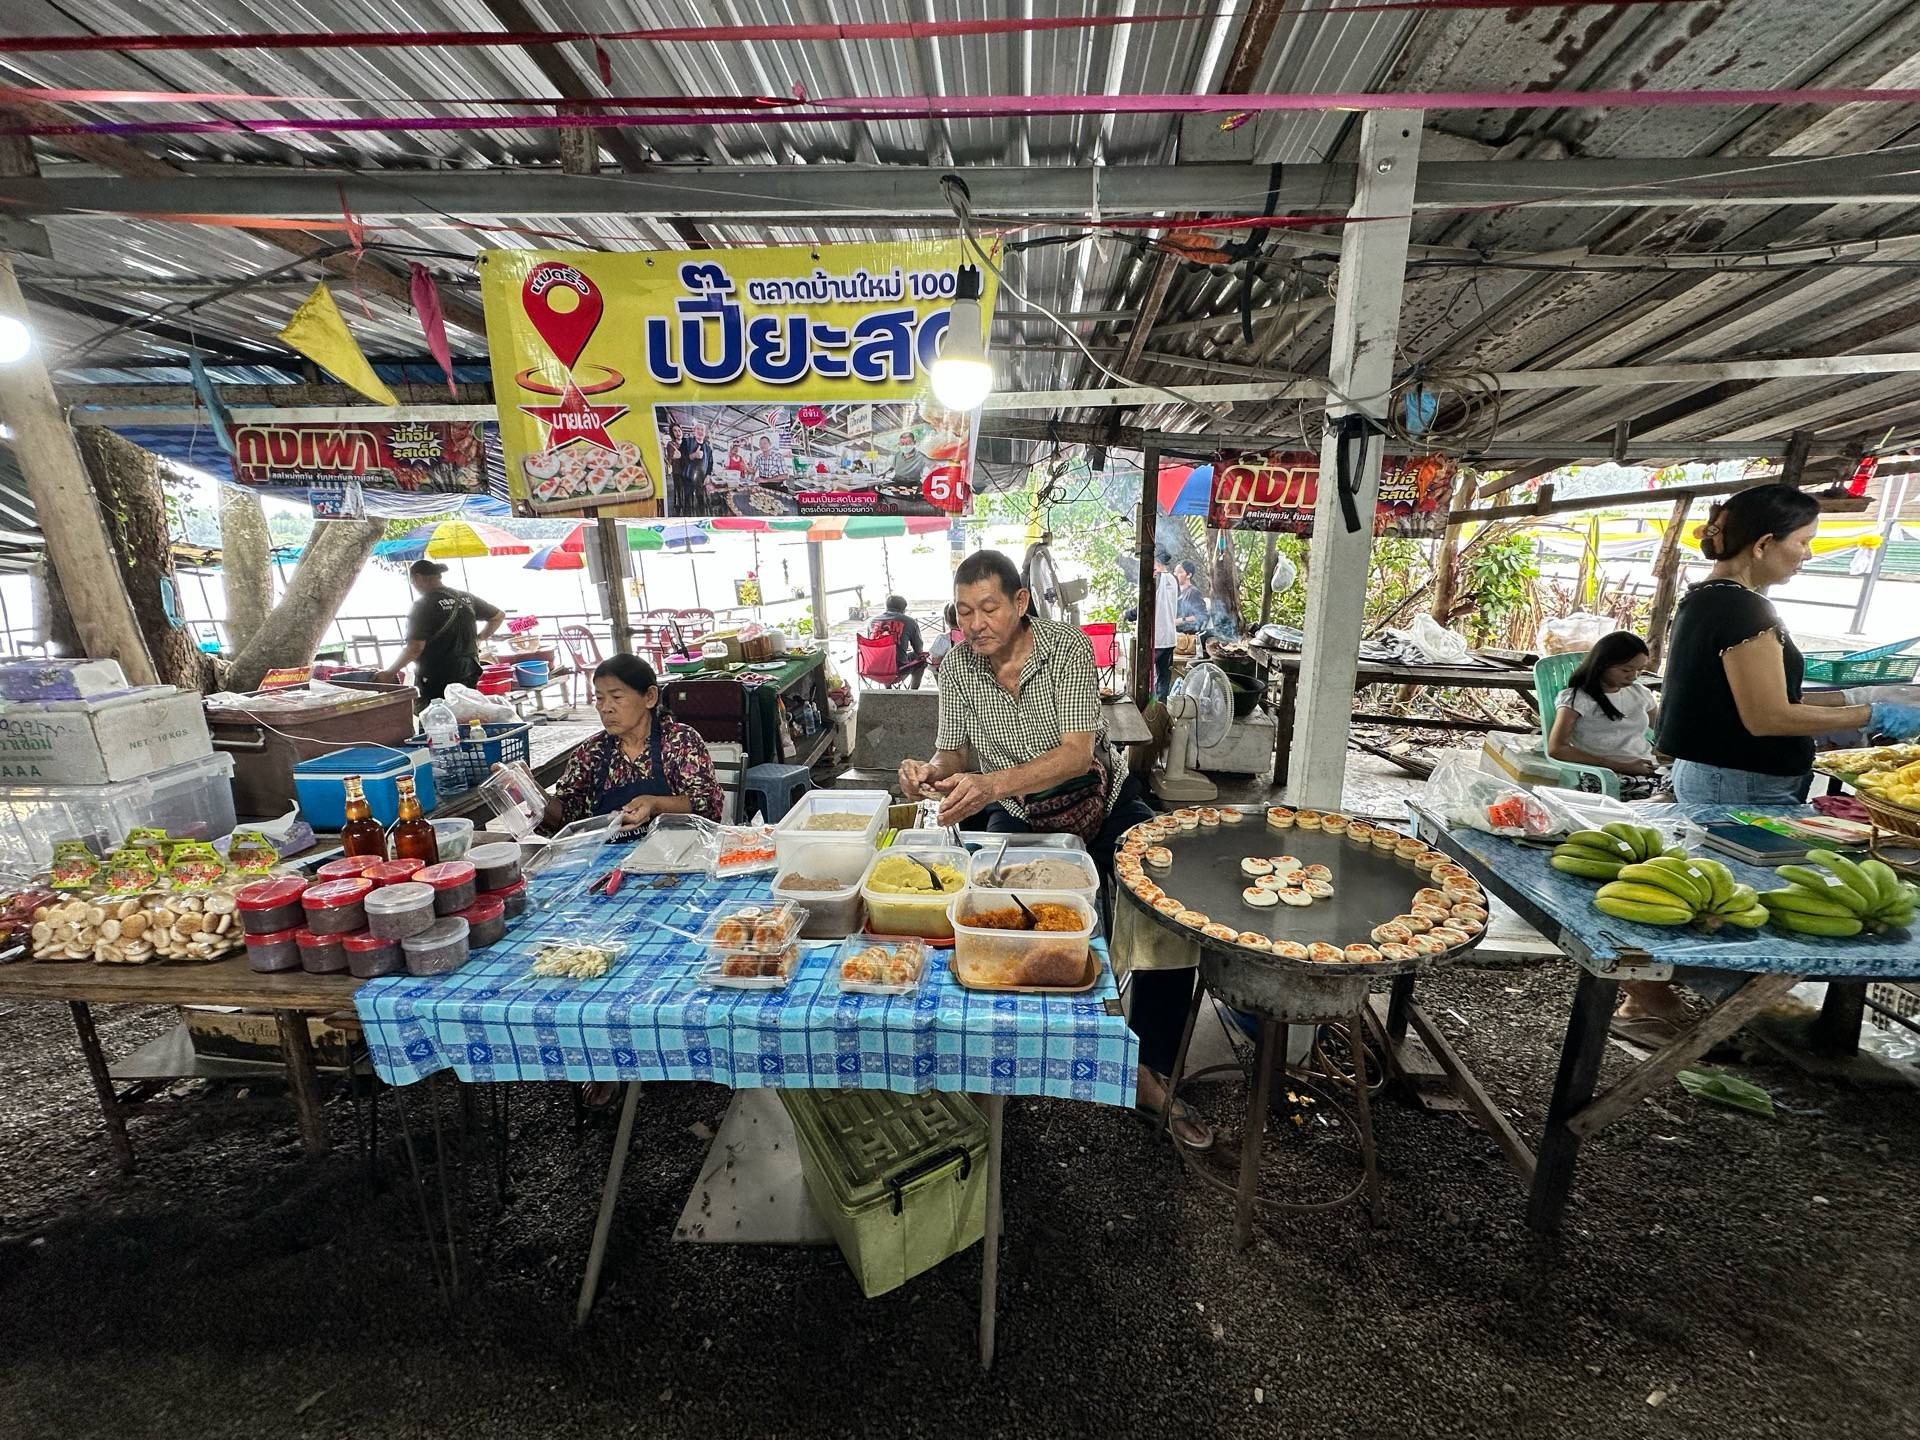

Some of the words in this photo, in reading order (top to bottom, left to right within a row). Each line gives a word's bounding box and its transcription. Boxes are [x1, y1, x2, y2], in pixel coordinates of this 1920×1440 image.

[531, 267, 590, 295] แปดริ้ว
[748, 269, 902, 301] ตลาดบ้านใหม่
[909, 271, 956, 297] 100
[552, 405, 600, 430] นายเล้ง
[395, 424, 434, 441] น้ำจิ้ม
[236, 423, 381, 481] กุงเผา
[393, 443, 441, 458] รสเด็ด
[930, 475, 950, 500] 5
[1386, 466, 1418, 485] น้ำจิ้
